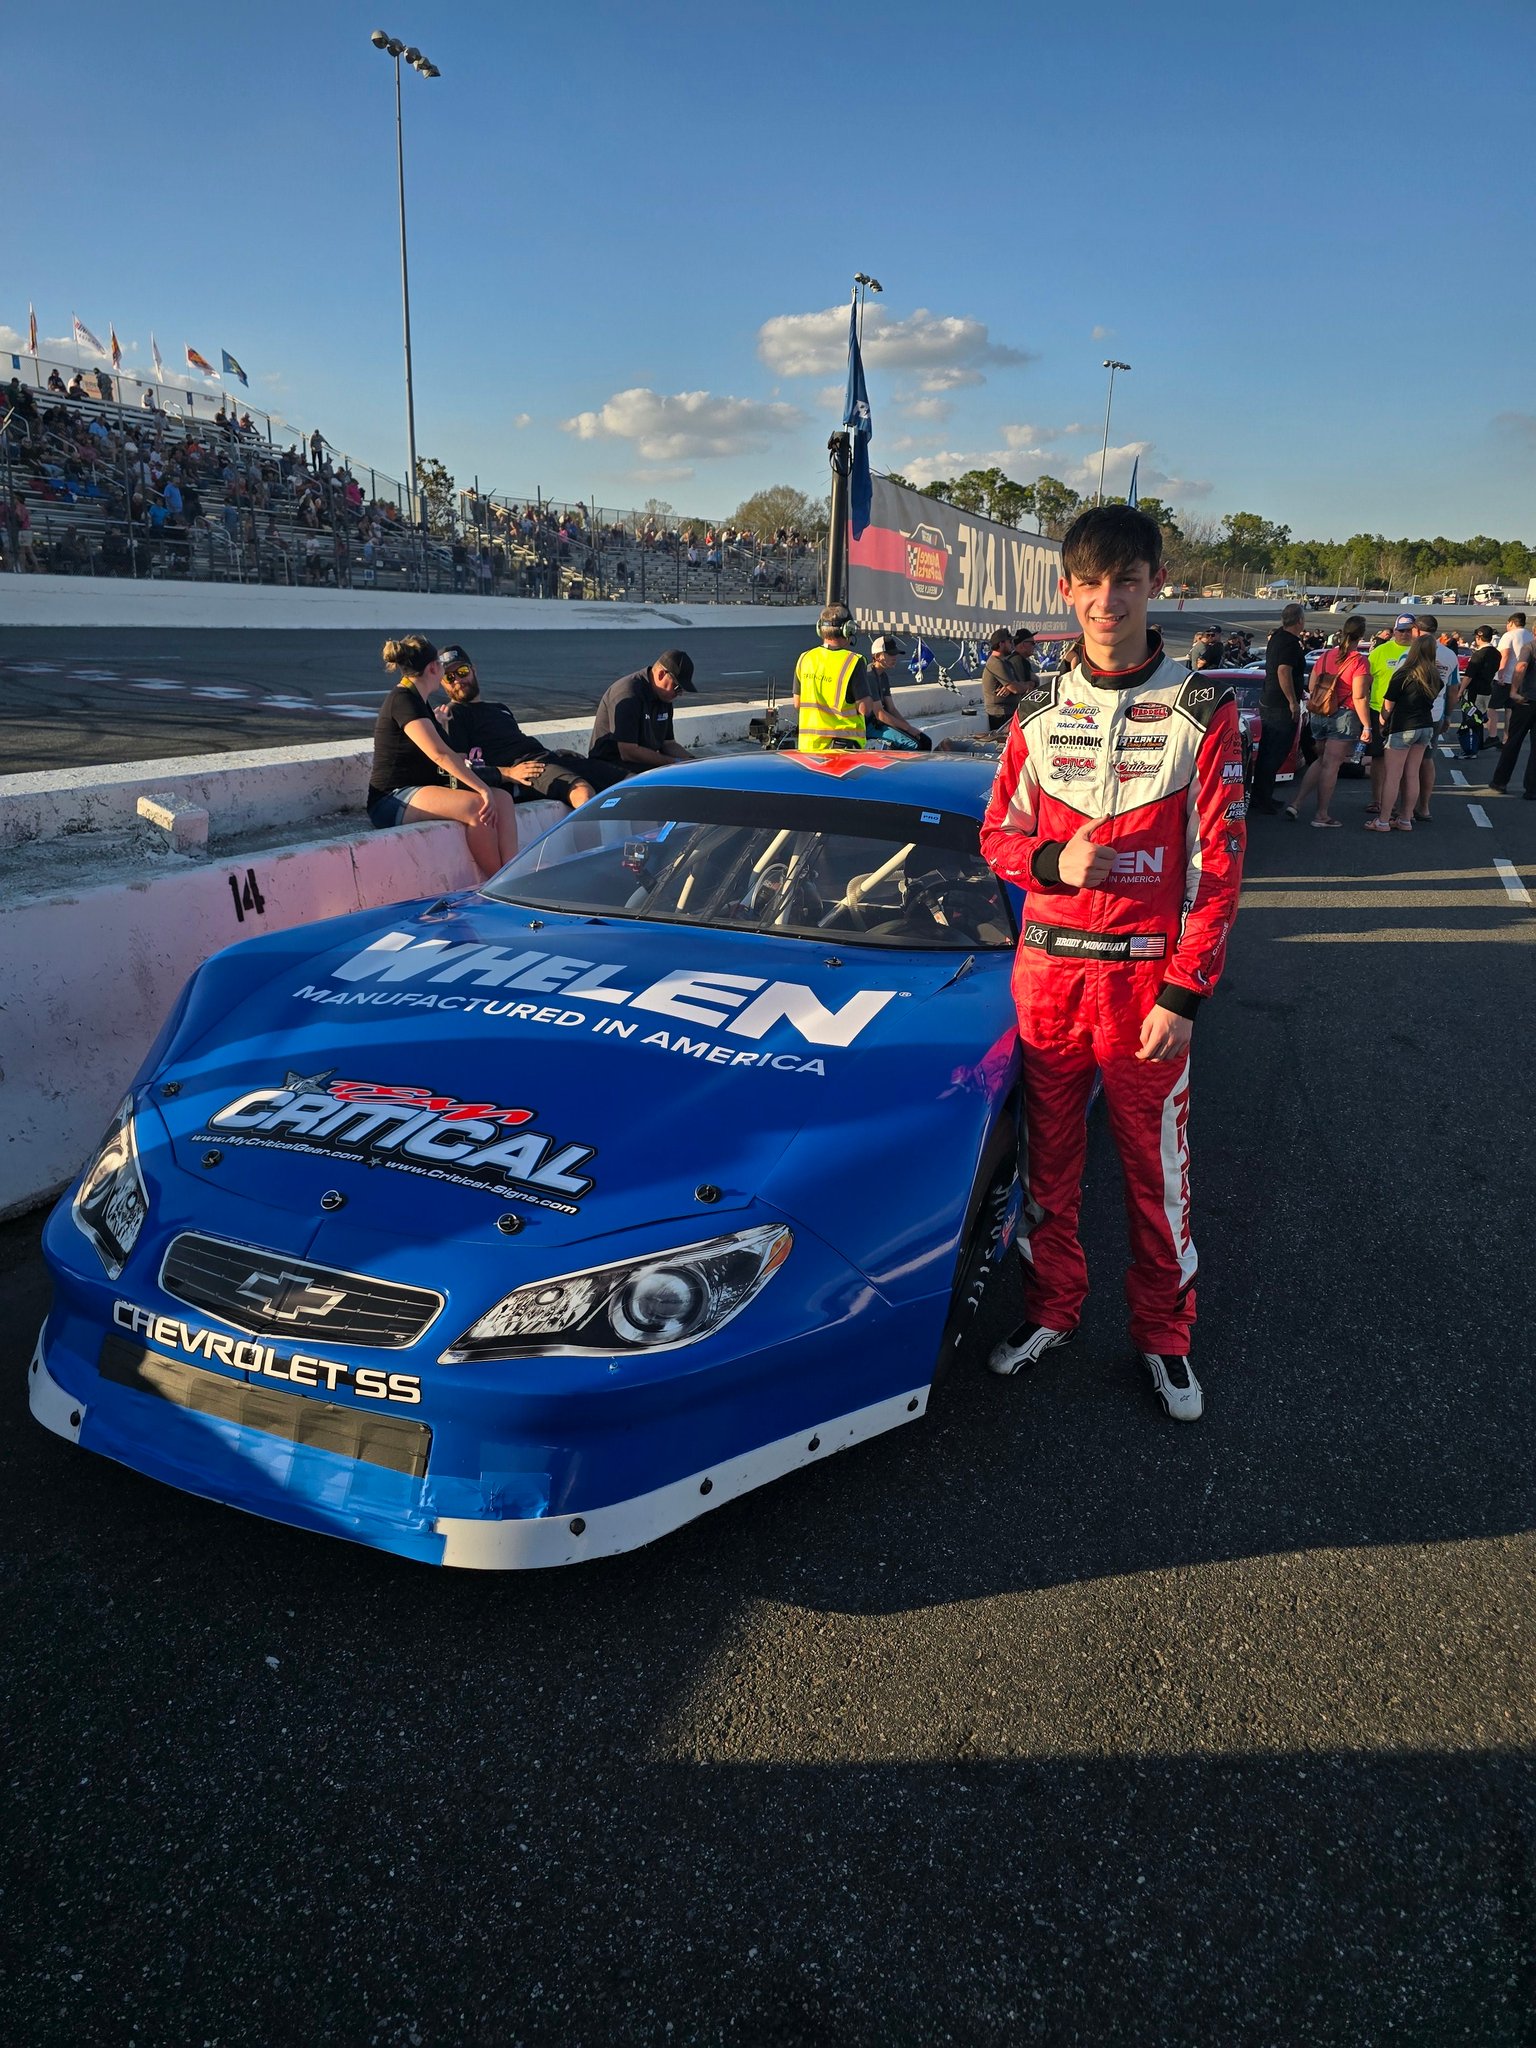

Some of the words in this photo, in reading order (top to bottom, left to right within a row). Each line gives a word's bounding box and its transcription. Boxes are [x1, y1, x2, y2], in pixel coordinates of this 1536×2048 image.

[1187, 687, 1215, 706] K1
[1061, 707, 1097, 716] SUNOCO
[1131, 707, 1168, 718] WADDELL
[1049, 734, 1103, 748] MOHAWK
[1118, 735, 1166, 746] ATLANTA
[1052, 756, 1097, 770] CRITICAL
[1109, 875, 1118, 883] IN
[1119, 875, 1161, 884] AMERICA
[229, 868, 265, 922] 14
[1025, 925, 1049, 945] K1
[1055, 937, 1082, 948] BRODY
[1081, 940, 1128, 952] MONAHAN
[332, 931, 897, 1047] WHELEN
[292, 985, 586, 1028] MANUFACTURED
[592, 1017, 640, 1039] IN
[640, 1030, 826, 1076] AMERICA
[328, 1079, 534, 1126] TEAM
[211, 1089, 592, 1194] CRITICAL
[191, 1134, 364, 1162] www.MyCriticalGear.com
[384, 1158, 578, 1215] www.Critical-Signs.com
[113, 1299, 348, 1391] CHEVROLET
[354, 1368, 421, 1404] SS
